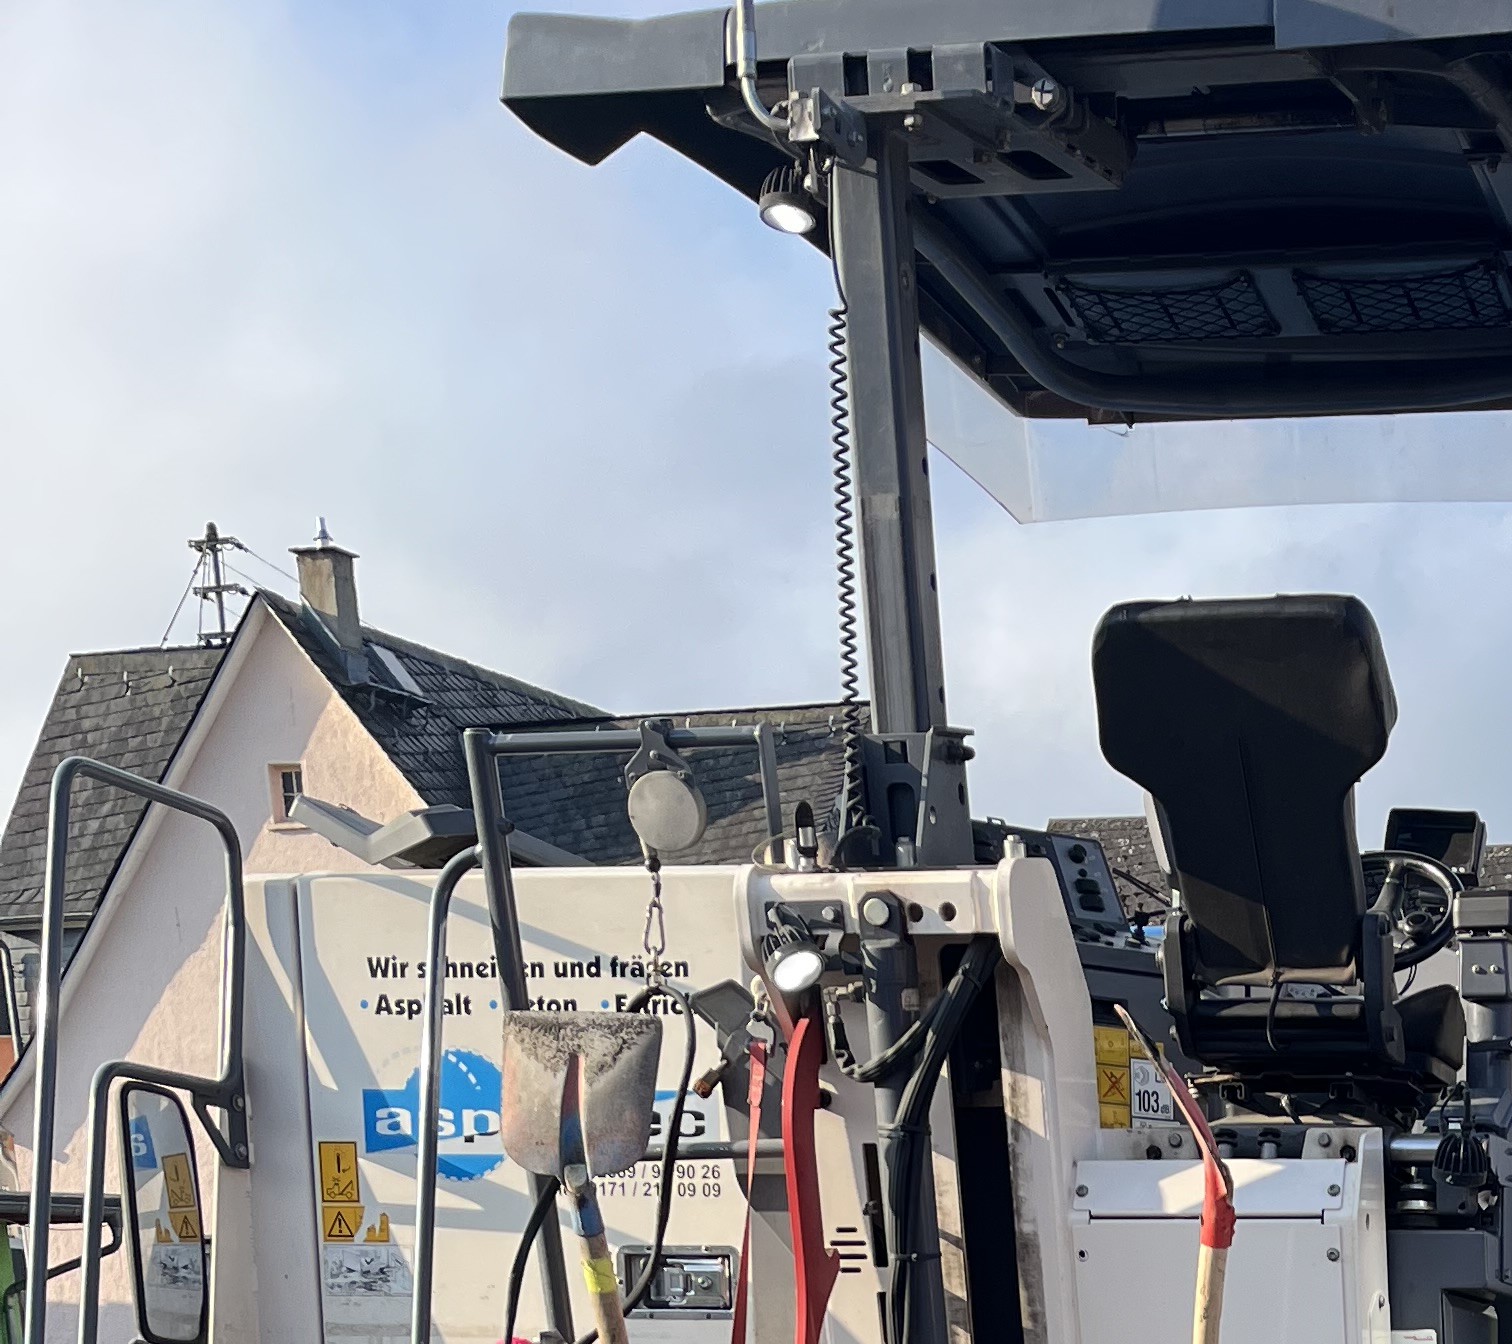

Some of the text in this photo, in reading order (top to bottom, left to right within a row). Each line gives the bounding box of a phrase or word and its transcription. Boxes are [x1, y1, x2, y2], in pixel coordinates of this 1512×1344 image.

[367, 954, 409, 978] Wir
[554, 956, 601, 978] und
[374, 993, 472, 1020] Aspalt
[1135, 1089, 1160, 1113] 103
[676, 1164, 695, 1179] 90
[701, 1164, 721, 1179] 26
[677, 1182, 696, 1197] 09
[702, 1182, 721, 1197] 09
